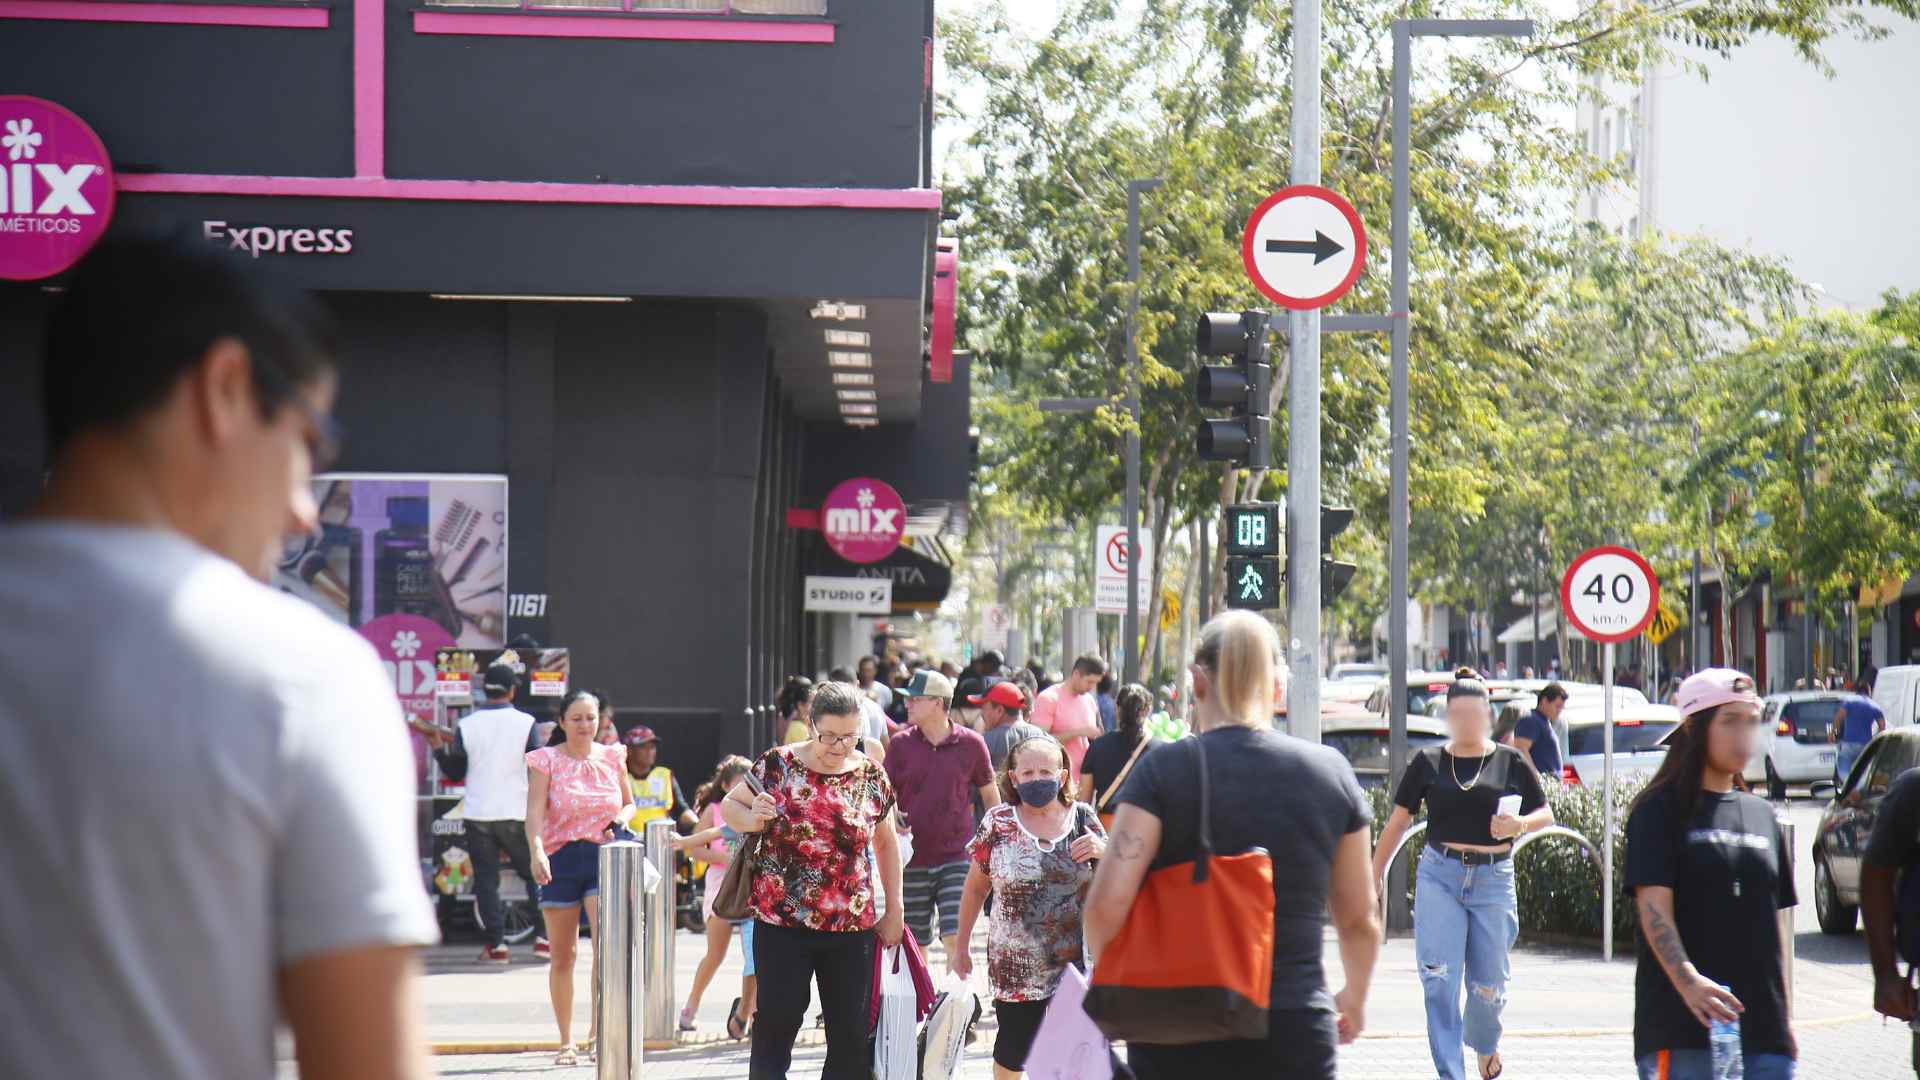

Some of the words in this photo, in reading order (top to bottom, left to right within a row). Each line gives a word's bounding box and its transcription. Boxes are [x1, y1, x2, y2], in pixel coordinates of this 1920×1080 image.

[0, 163, 97, 214] ix
[203, 220, 353, 259] Express
[826, 507, 899, 533] mix
[1238, 515, 1266, 546] 08
[809, 588, 866, 602] STUDIO
[1582, 573, 1634, 604] 40
[508, 593, 548, 617] 1161
